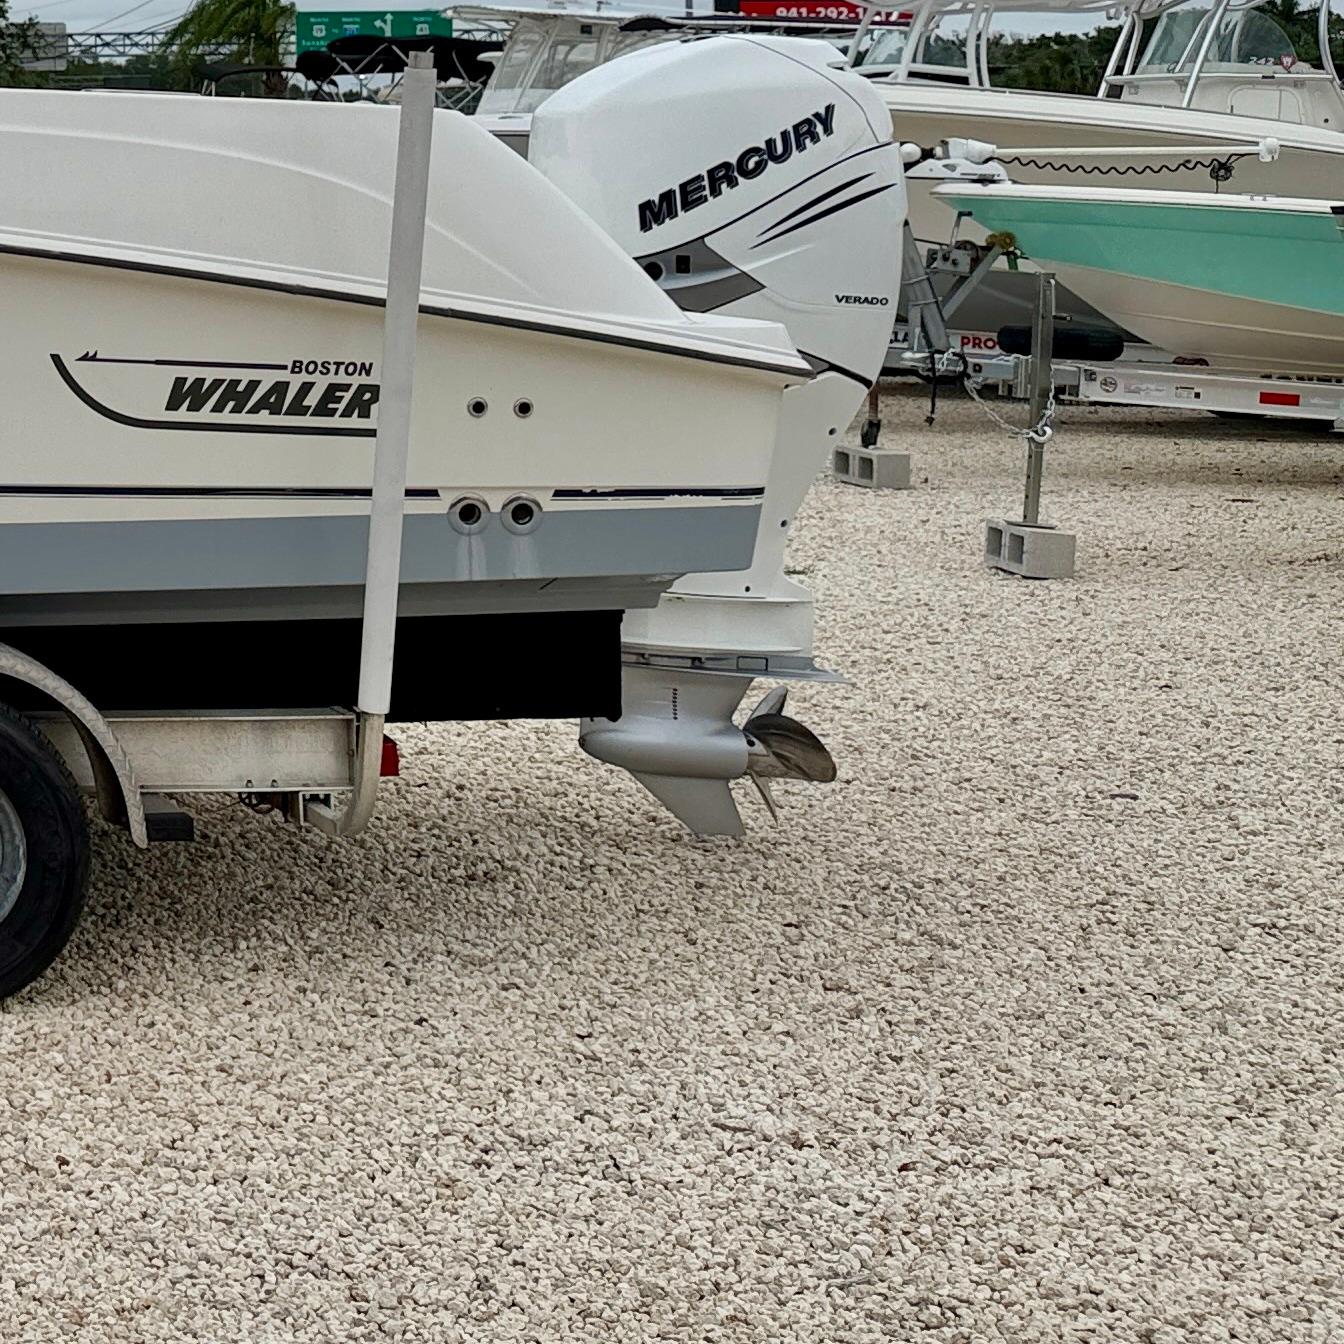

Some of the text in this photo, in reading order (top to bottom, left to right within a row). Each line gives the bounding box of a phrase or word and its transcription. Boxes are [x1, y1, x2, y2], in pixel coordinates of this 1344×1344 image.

[637, 103, 835, 233] MERCURY
[834, 294, 889, 306] VERADO
[290, 359, 373, 377] BOSTON
[164, 377, 381, 419] WHALER
